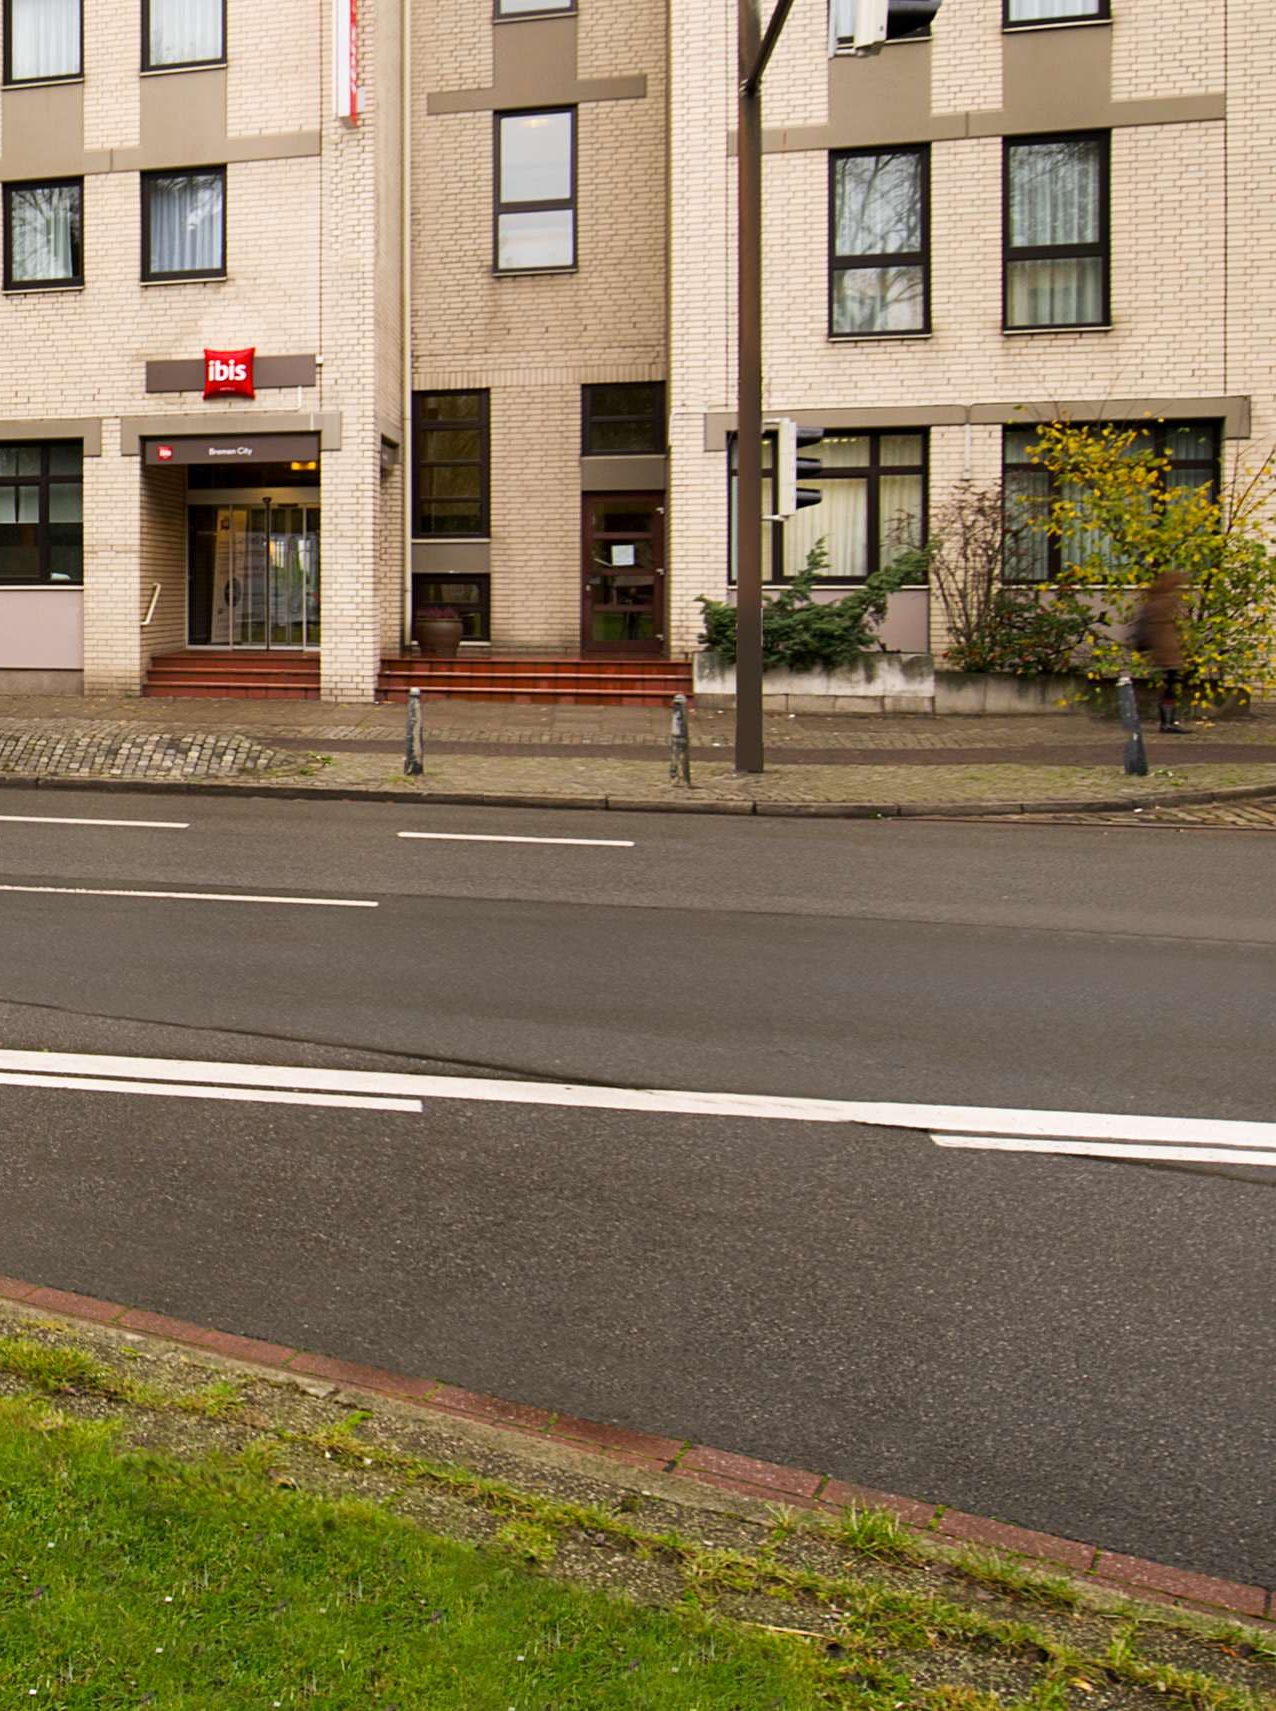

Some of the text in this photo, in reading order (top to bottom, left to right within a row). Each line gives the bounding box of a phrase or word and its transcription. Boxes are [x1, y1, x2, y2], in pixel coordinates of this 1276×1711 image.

[208, 359, 247, 382] ibis
[209, 446, 253, 457] Bremen City
